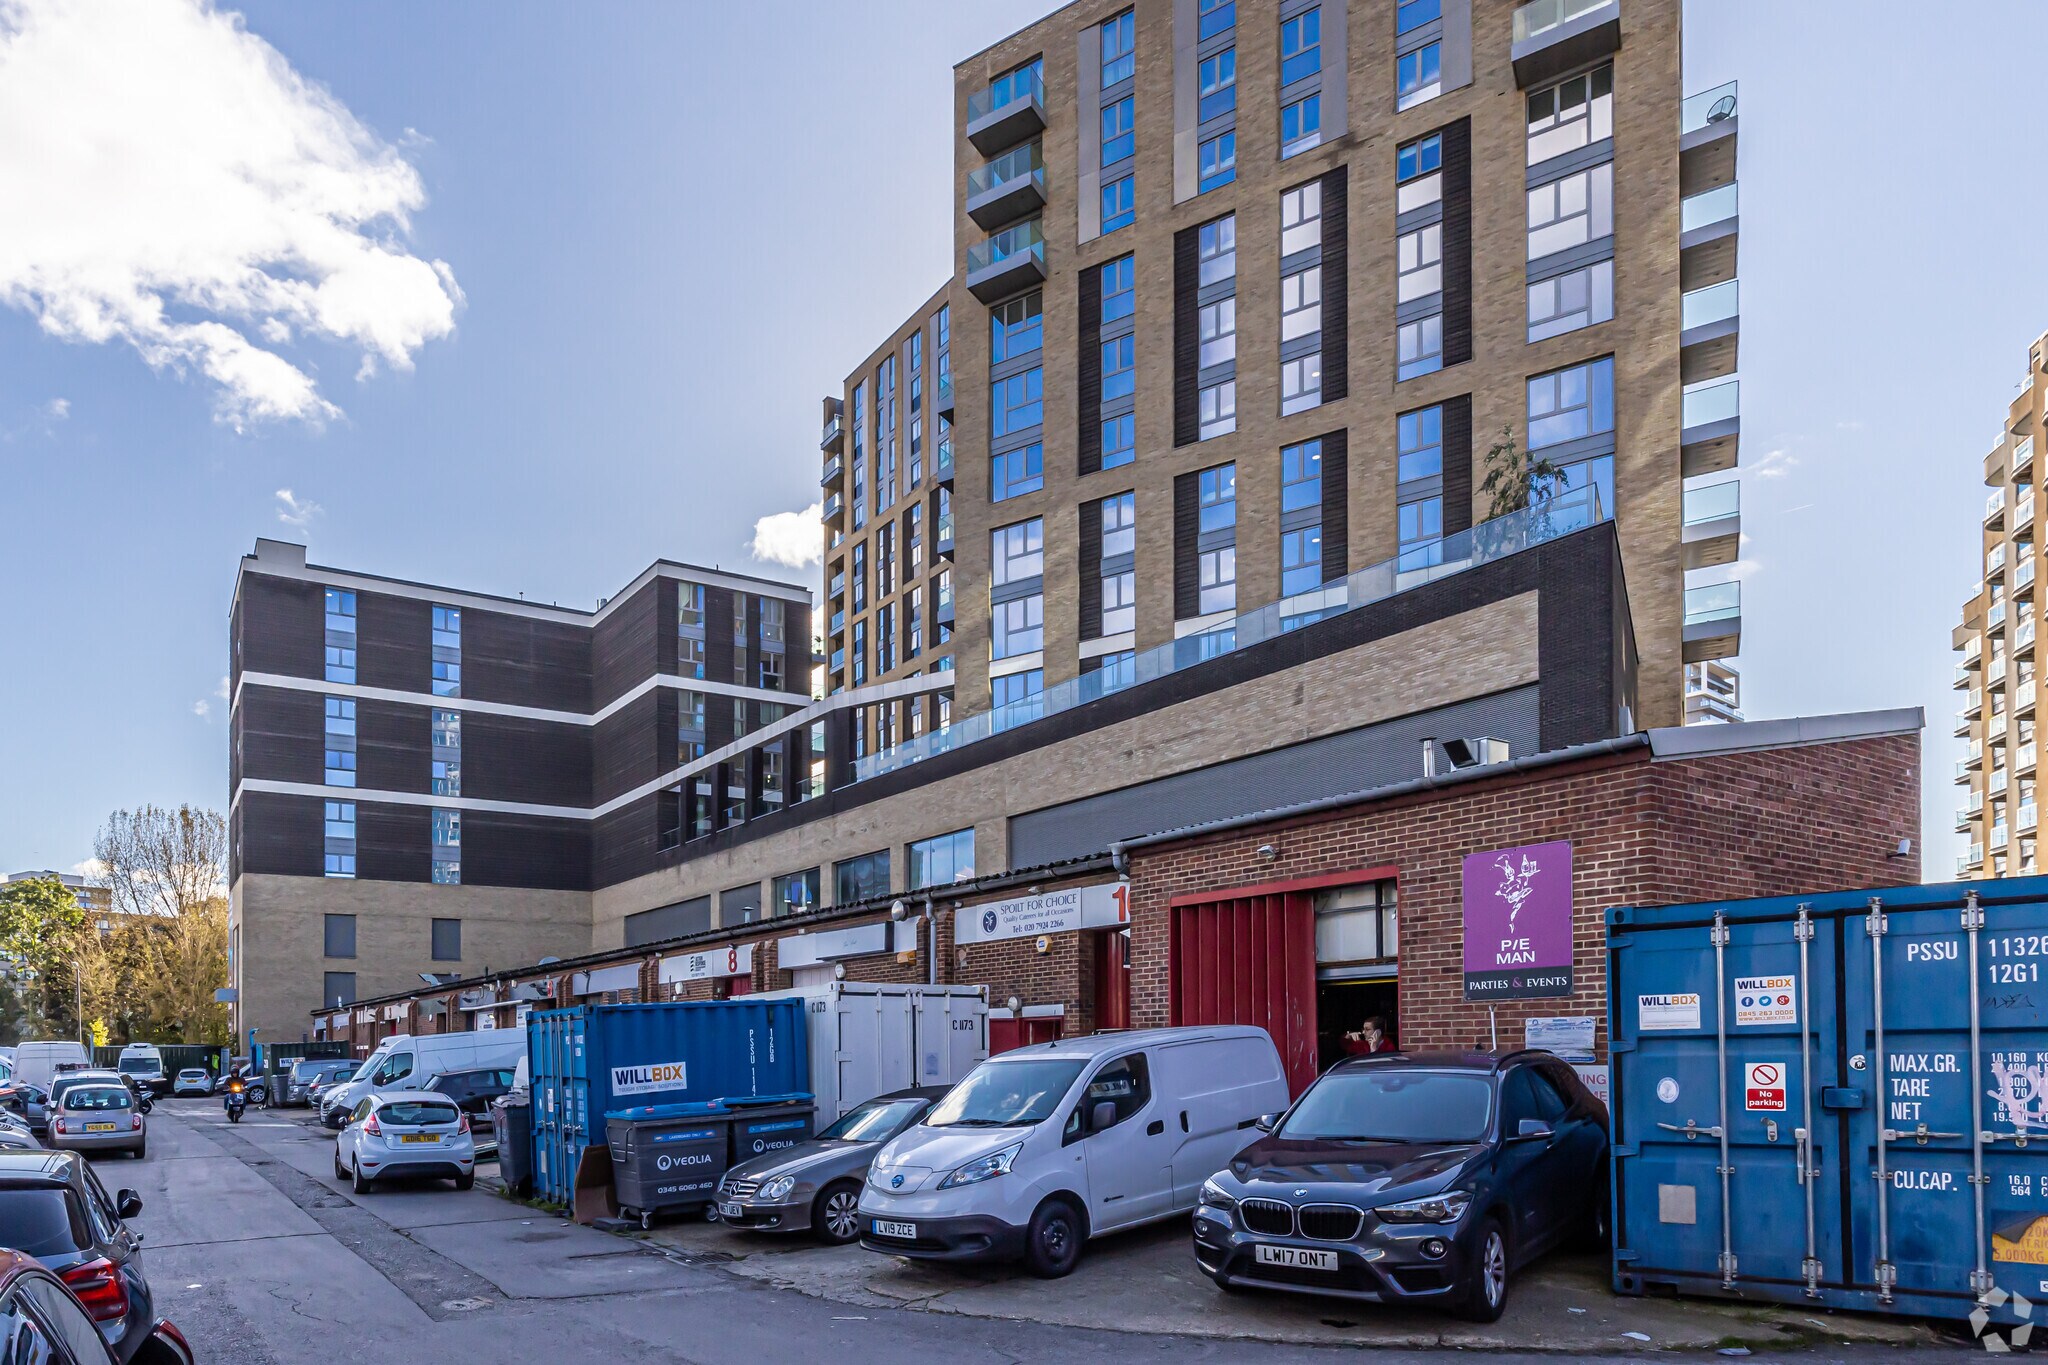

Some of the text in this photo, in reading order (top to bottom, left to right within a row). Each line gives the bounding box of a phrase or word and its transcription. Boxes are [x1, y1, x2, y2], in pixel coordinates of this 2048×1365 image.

[1000, 893, 1077, 915] SPOILT FOR CHOICE
[1112, 885, 1130, 922] 1
[1012, 925, 1023, 934] Tel:
[1024, 923, 1035, 932] 020
[1050, 919, 1065, 929] 2266
[1496, 951, 1536, 965] MAN
[1907, 941, 1958, 962] PSSU
[727, 949, 738, 973] 8
[1989, 962, 2038, 984] 12G1
[1469, 976, 1568, 991] PARTIES & EVENTS
[1737, 979, 1792, 990] WILLBOX
[1641, 995, 1697, 1006] WILLBOX
[952, 1020, 958, 1031] C
[1890, 1054, 1961, 1073] MAX.GR.
[615, 1065, 683, 1085] WILLBOX
[1759, 1090, 1773, 1098] No
[1891, 1078, 1931, 1097] TARE
[1749, 1098, 1784, 1108] parking
[765, 1140, 794, 1150] VEOLIA
[673, 1154, 712, 1167] VEOLIA
[1893, 1170, 1958, 1191] CU.CAP.
[2008, 1175, 2031, 1185] 16.0
[657, 1182, 713, 1194] 0345 6060 460
[2011, 1186, 2031, 1196] 564
[877, 1222, 913, 1236] LV19 ZCE
[1263, 1248, 1328, 1267] LW17 ONT
